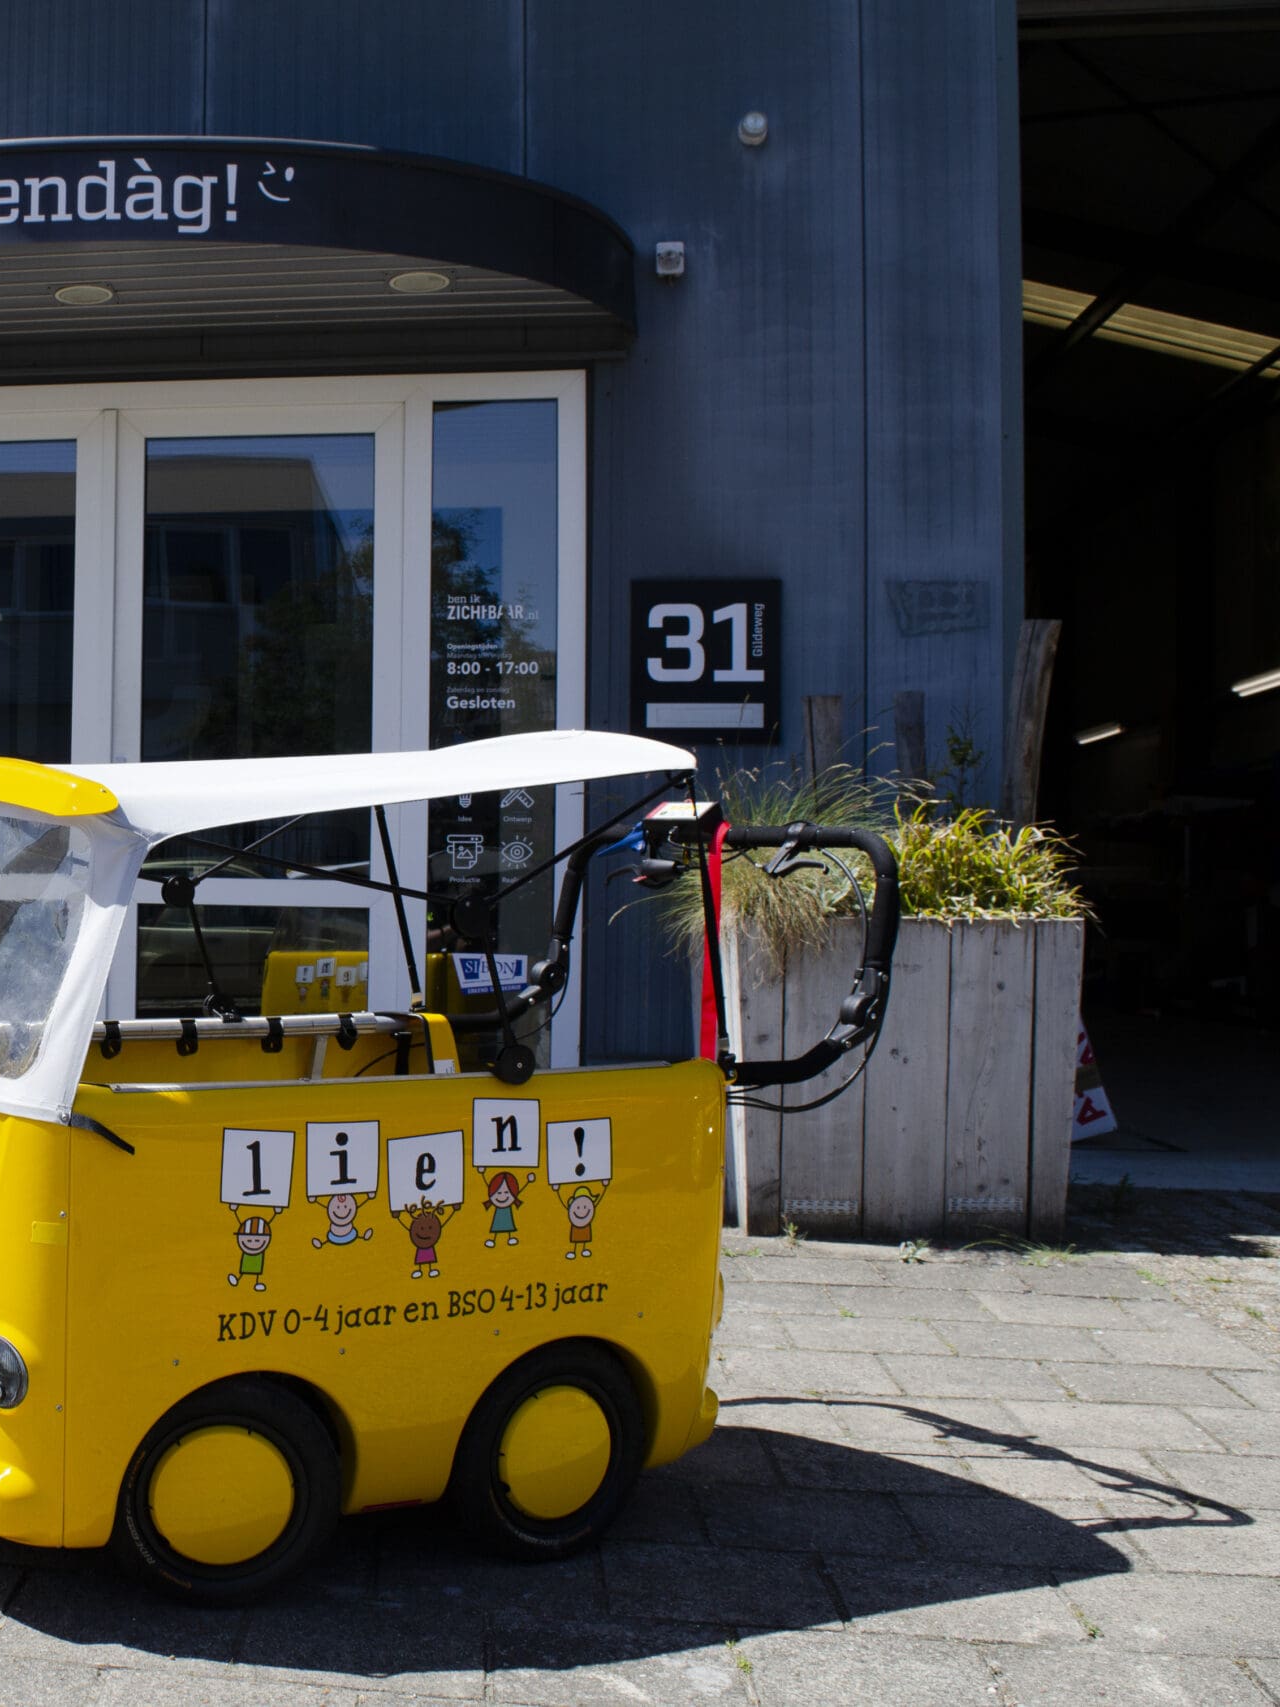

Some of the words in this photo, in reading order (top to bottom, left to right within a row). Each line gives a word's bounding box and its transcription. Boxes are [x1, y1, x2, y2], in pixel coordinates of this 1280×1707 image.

[447, 593, 467, 604] ben
[469, 593, 481, 604] ik
[646, 602, 766, 683] 31
[752, 603, 766, 657] Gildeweg
[447, 661, 481, 675] 8:00
[496, 661, 539, 675] 17:00
[446, 696, 516, 709] Gesloten
[217, 1309, 277, 1342] KDV
[334, 1304, 397, 1336] jaar
[403, 1298, 440, 1323] en
[447, 1288, 497, 1319] BSO
[499, 1281, 548, 1312] 4-13
[551, 1280, 610, 1312] jaar
